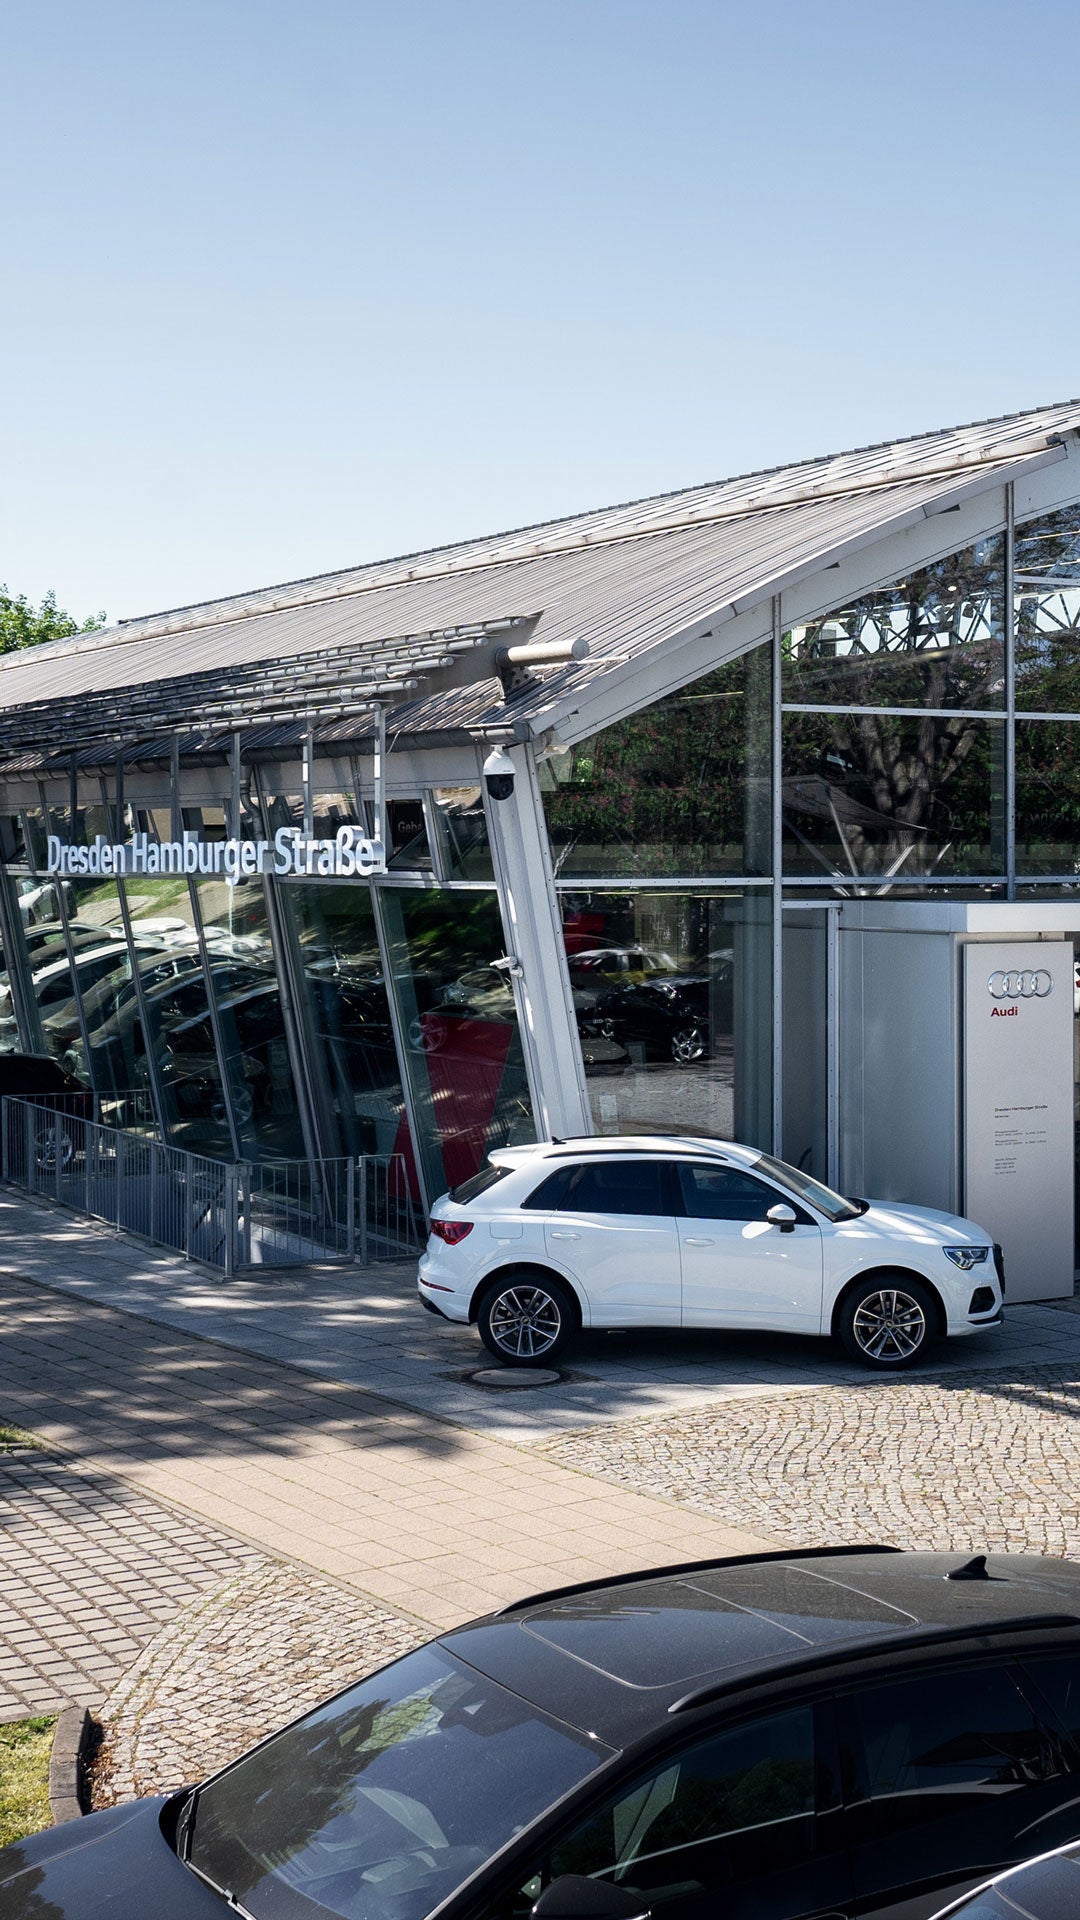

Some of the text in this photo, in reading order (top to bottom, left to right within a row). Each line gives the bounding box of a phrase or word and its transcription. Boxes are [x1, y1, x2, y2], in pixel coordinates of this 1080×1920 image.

[47, 825, 375, 887] Dresden Hamburger Straße
[991, 1006, 1019, 1017] Audi
